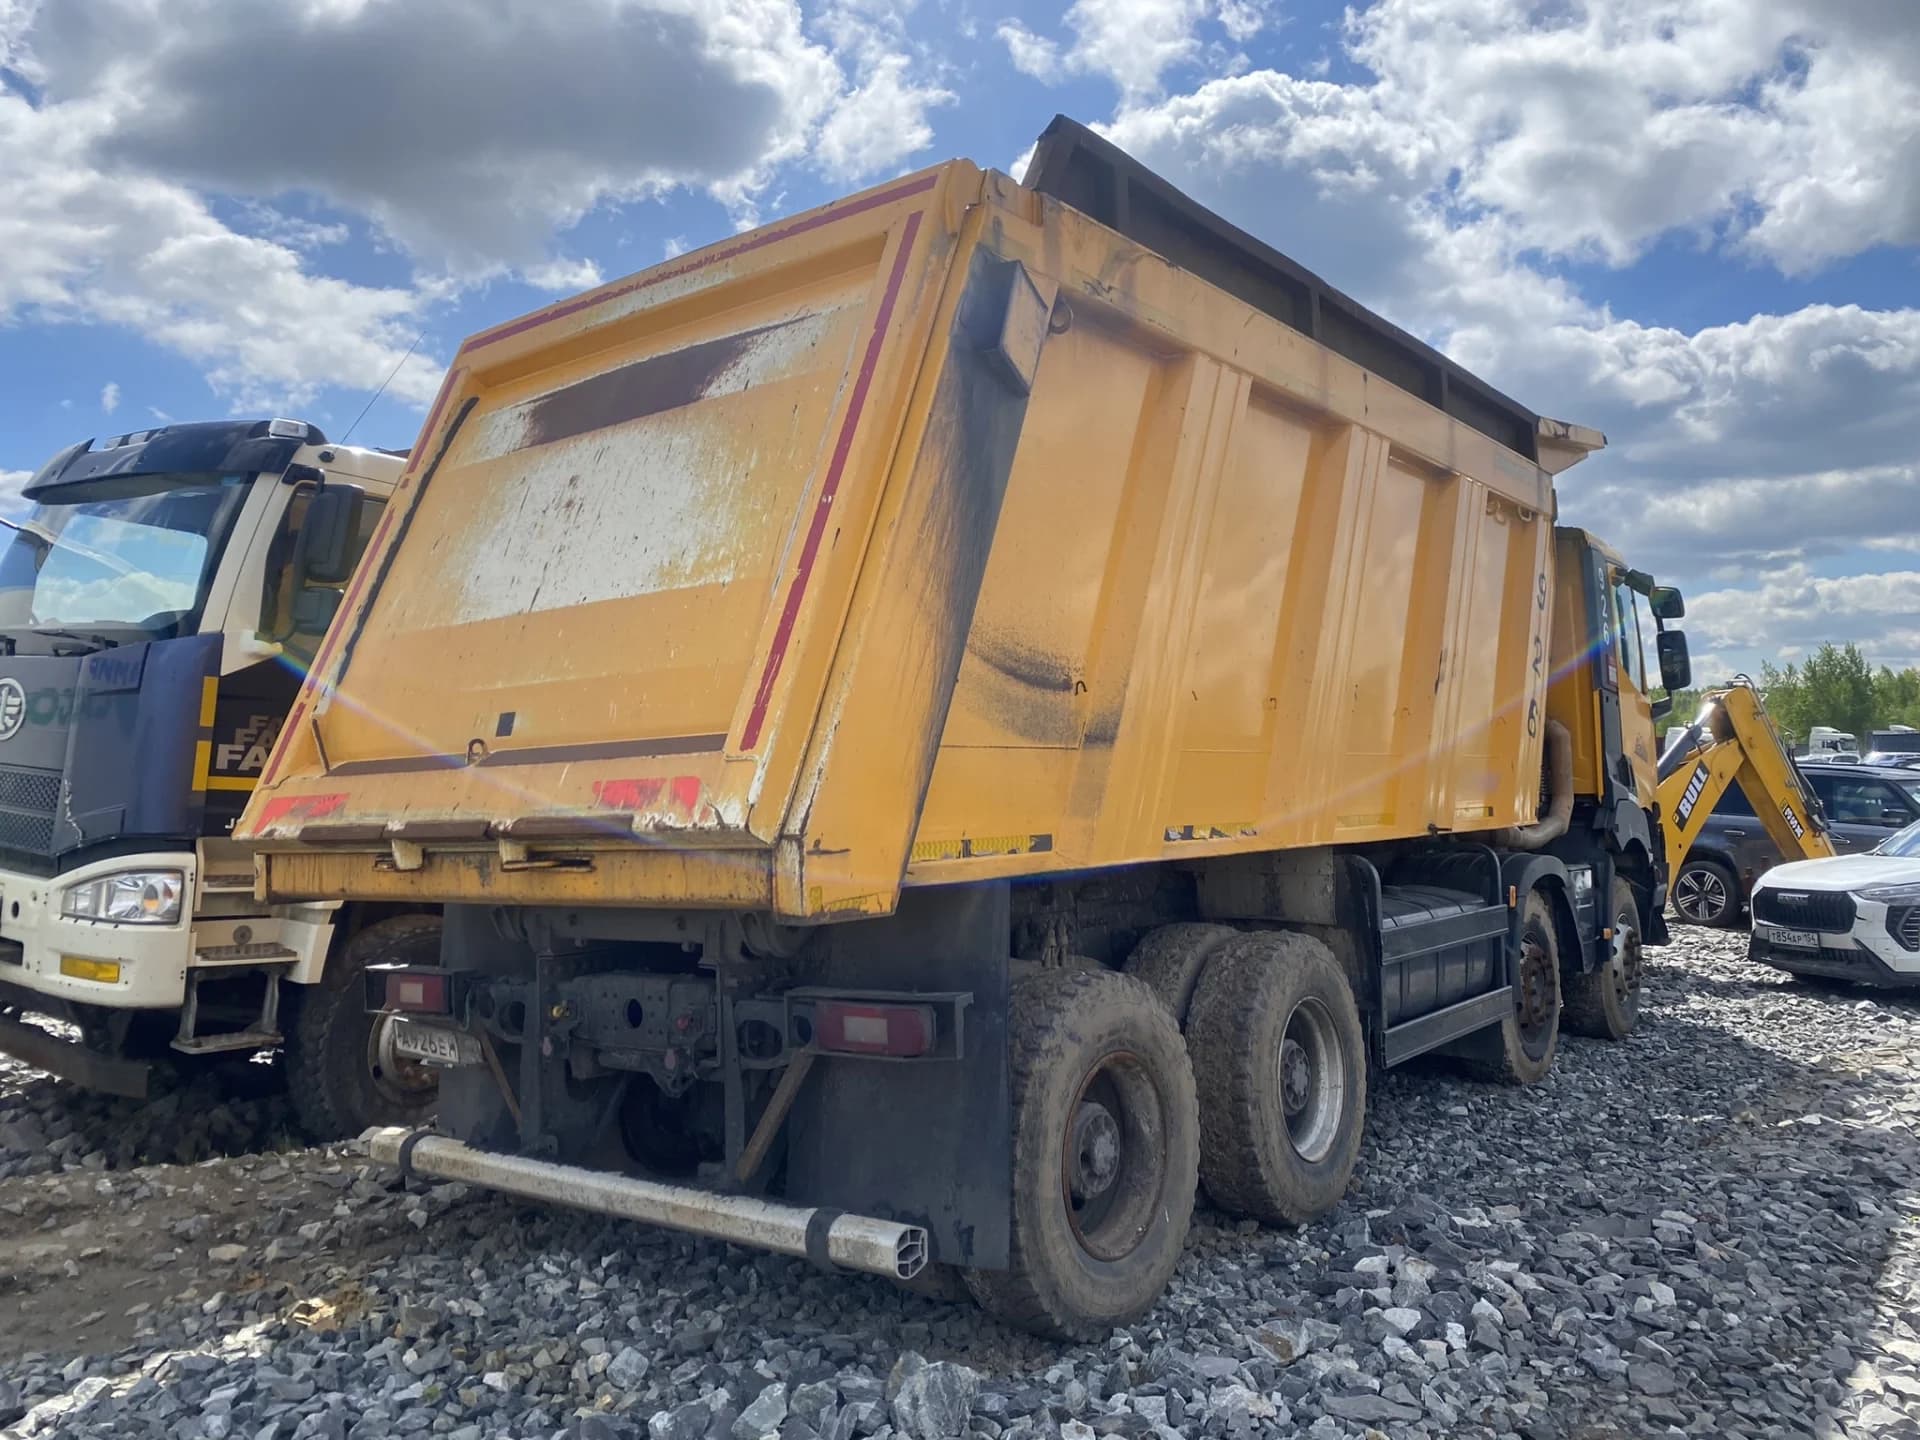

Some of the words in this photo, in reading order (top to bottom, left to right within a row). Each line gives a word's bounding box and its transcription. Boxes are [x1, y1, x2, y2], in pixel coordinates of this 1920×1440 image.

[1598, 566, 1610, 646] 926
[1527, 573, 1548, 738] 926
[216, 744, 268, 770] FA
[1678, 767, 1708, 820] BULL
